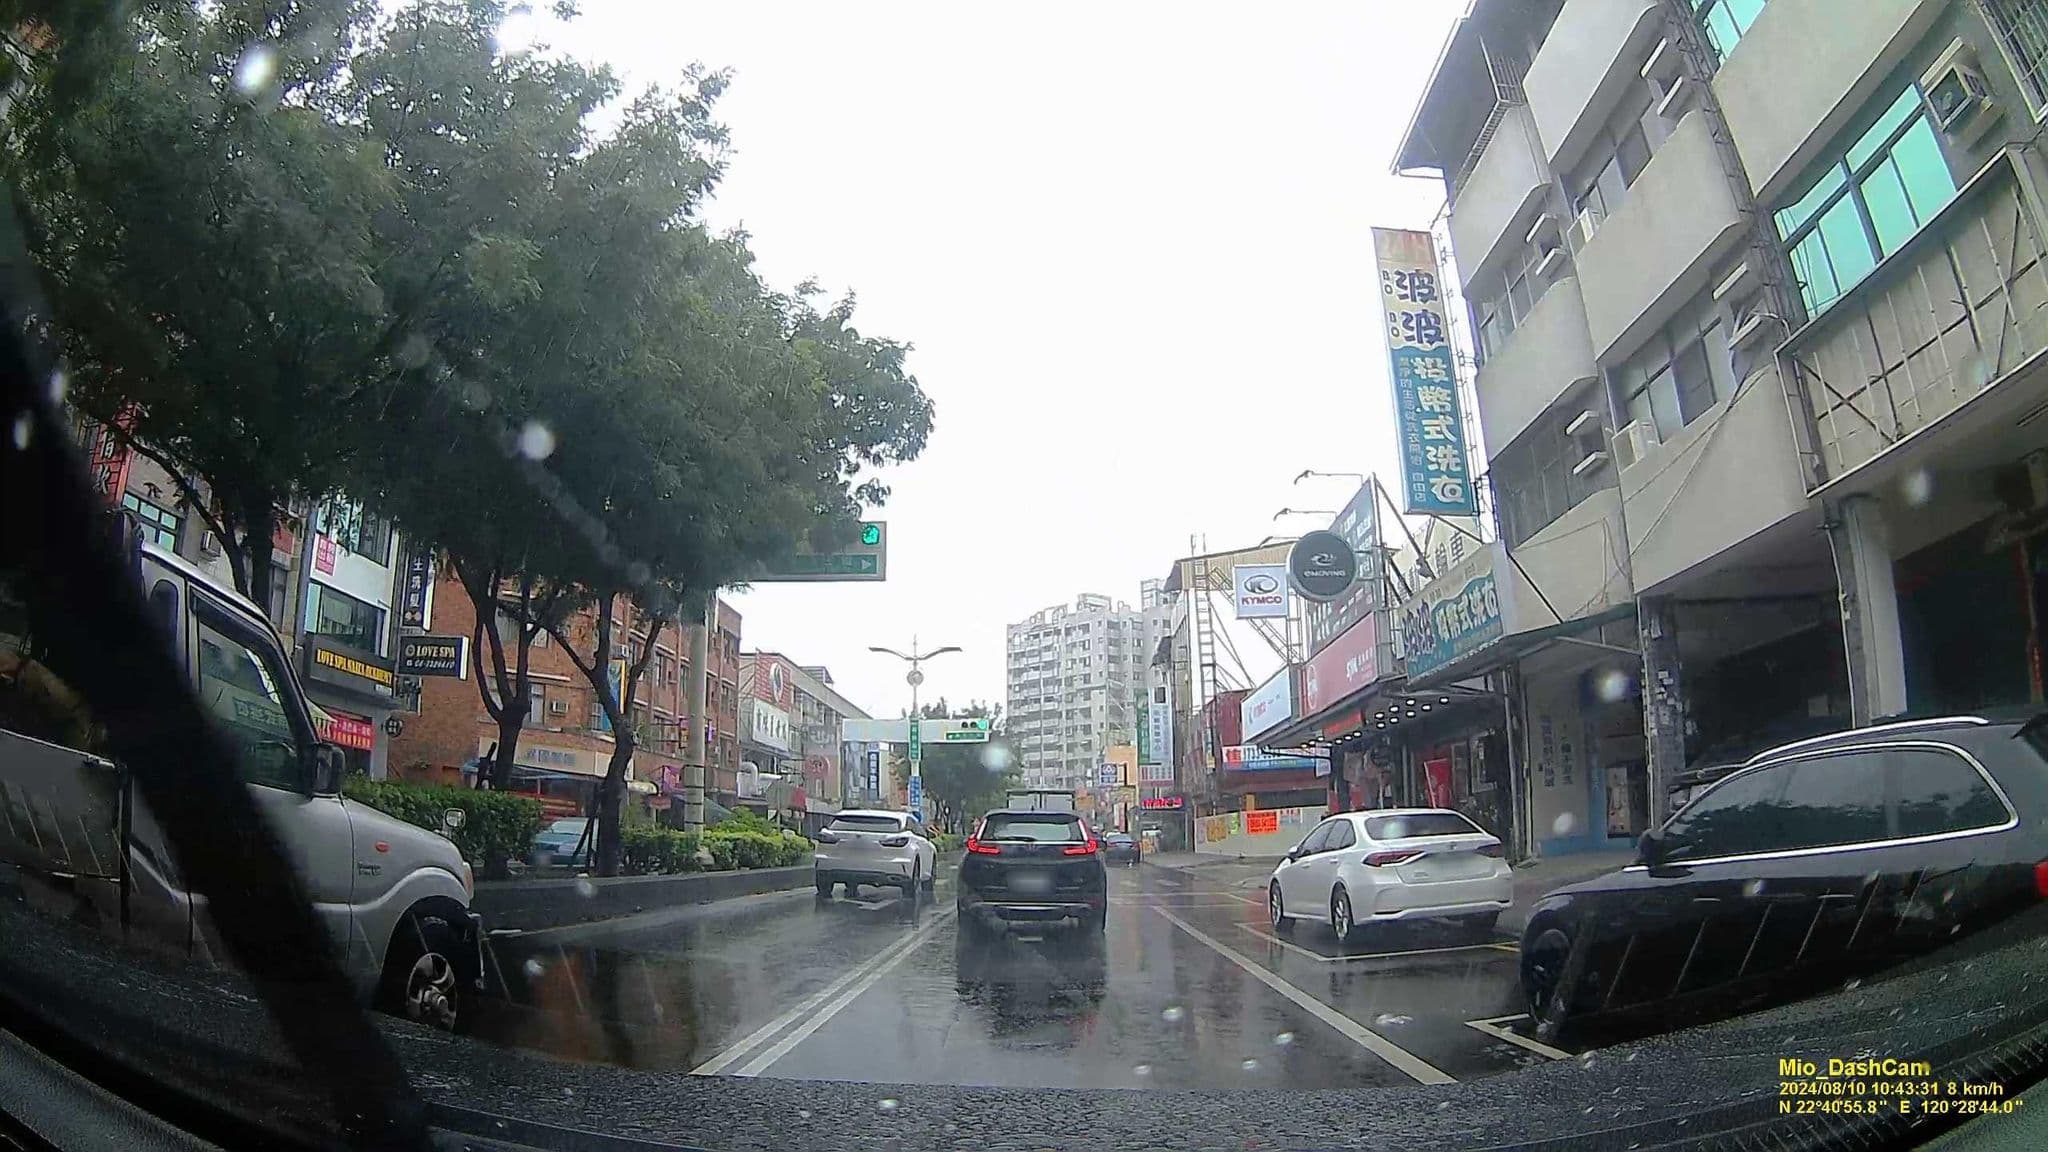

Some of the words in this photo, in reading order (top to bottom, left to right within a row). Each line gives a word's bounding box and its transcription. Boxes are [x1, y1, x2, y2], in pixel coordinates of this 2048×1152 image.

[1241, 596, 1283, 606] KYMCO
[316, 649, 333, 667] LOVE
[416, 645, 438, 658] LOVE
[439, 646, 456, 658] SPA
